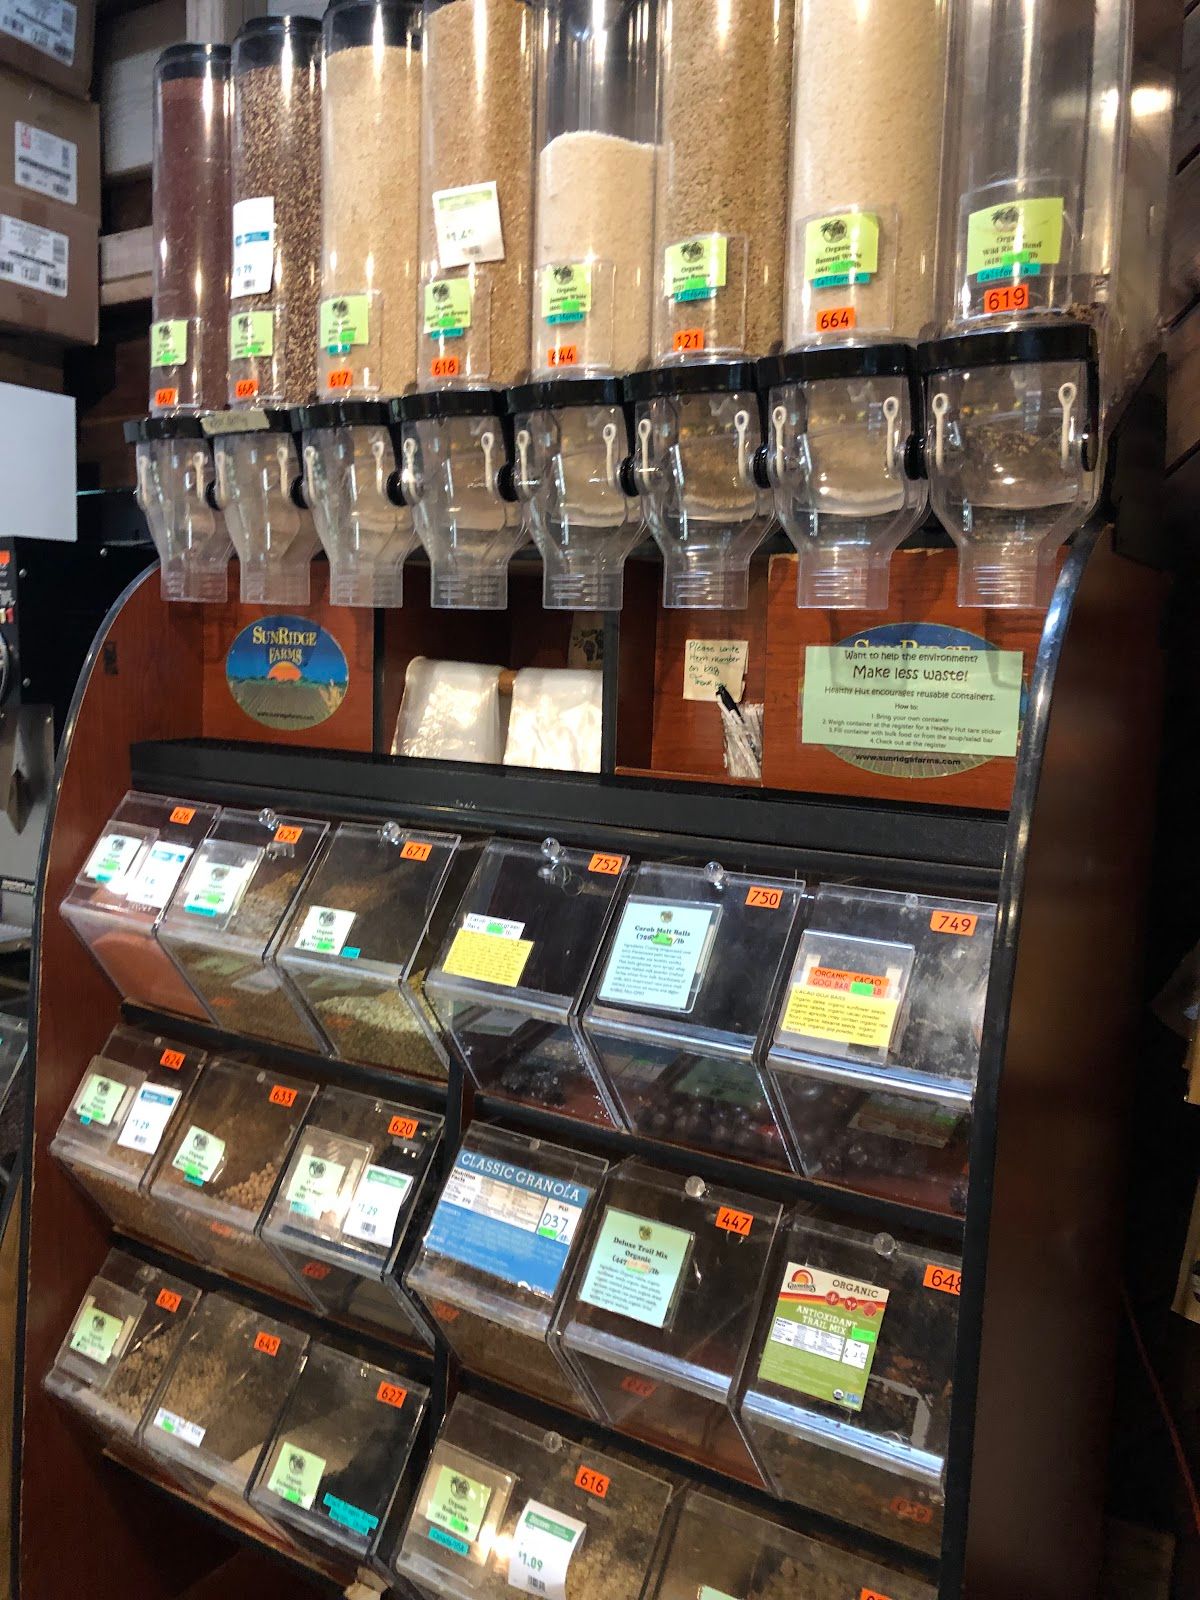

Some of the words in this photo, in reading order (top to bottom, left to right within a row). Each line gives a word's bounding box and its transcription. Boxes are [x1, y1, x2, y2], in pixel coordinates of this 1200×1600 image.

[988, 287, 1026, 311] 619
[820, 310, 850, 330] 664
[434, 359, 456, 376] 618
[688, 641, 715, 653] Please
[844, 649, 867, 661] Want
[869, 652, 880, 660] to
[881, 652, 900, 661] help
[901, 652, 917, 661] the
[918, 653, 979, 664] environment?
[852, 664, 891, 680] Make
[894, 667, 920, 680] less
[922, 669, 969, 682] waste!
[824, 685, 853, 695] Healthy
[854, 687, 871, 696] Hut
[871, 688, 915, 698] encourages
[916, 689, 950, 700] reusable
[950, 692, 997, 702] containers.
[894, 702, 909, 711] How
[910, 703, 919, 711] to:
[828, 718, 845, 727] Weigh
[846, 719, 873, 727] container
[891, 722, 915, 731] register
[915, 722, 925, 731] for
[930, 724, 954, 733] Healthy
[955, 725, 967, 733] Hut
[967, 726, 981, 734] tare
[981, 727, 1003, 735] sticker
[876, 713, 892, 721] Bring
[892, 714, 907, 722] your
[921, 716, 950, 724] container
[843, 728, 870, 736] container
[884, 729, 897, 737] bulk
[898, 730, 913, 738] food
[921, 731, 936, 739] from
[948, 734, 982, 744] soup/salad
[875, 738, 893, 746] Check
[923, 741, 947, 750] register
[172, 809, 190, 822] 626
[405, 844, 427, 858] 671
[592, 856, 619, 873] 752
[750, 888, 780, 907] 750
[634, 924, 655, 934] Carob
[656, 926, 673, 936] Malt
[673, 928, 691, 938] Balls
[937, 914, 972, 933] 749
[814, 969, 848, 981] ORGANIC
[854, 975, 882, 986] CACAO
[391, 1120, 414, 1135] 620
[460, 1151, 516, 1180] CLASSIC
[514, 1169, 582, 1203] GRANOLA
[541, 1212, 570, 1239] 037
[721, 1211, 750, 1232] 447
[613, 1235, 637, 1250] Deluxe
[638, 1244, 656, 1256] Trail
[655, 1250, 669, 1261] Mix
[831, 1278, 880, 1299] ORGANIC
[930, 1268, 962, 1294] 648
[795, 1304, 859, 1331] ANTIOXIDANT
[801, 1315, 828, 1333] TRAIL
[827, 1323, 848, 1336] MIX
[381, 1385, 404, 1404] 627
[579, 1471, 605, 1495] 616
